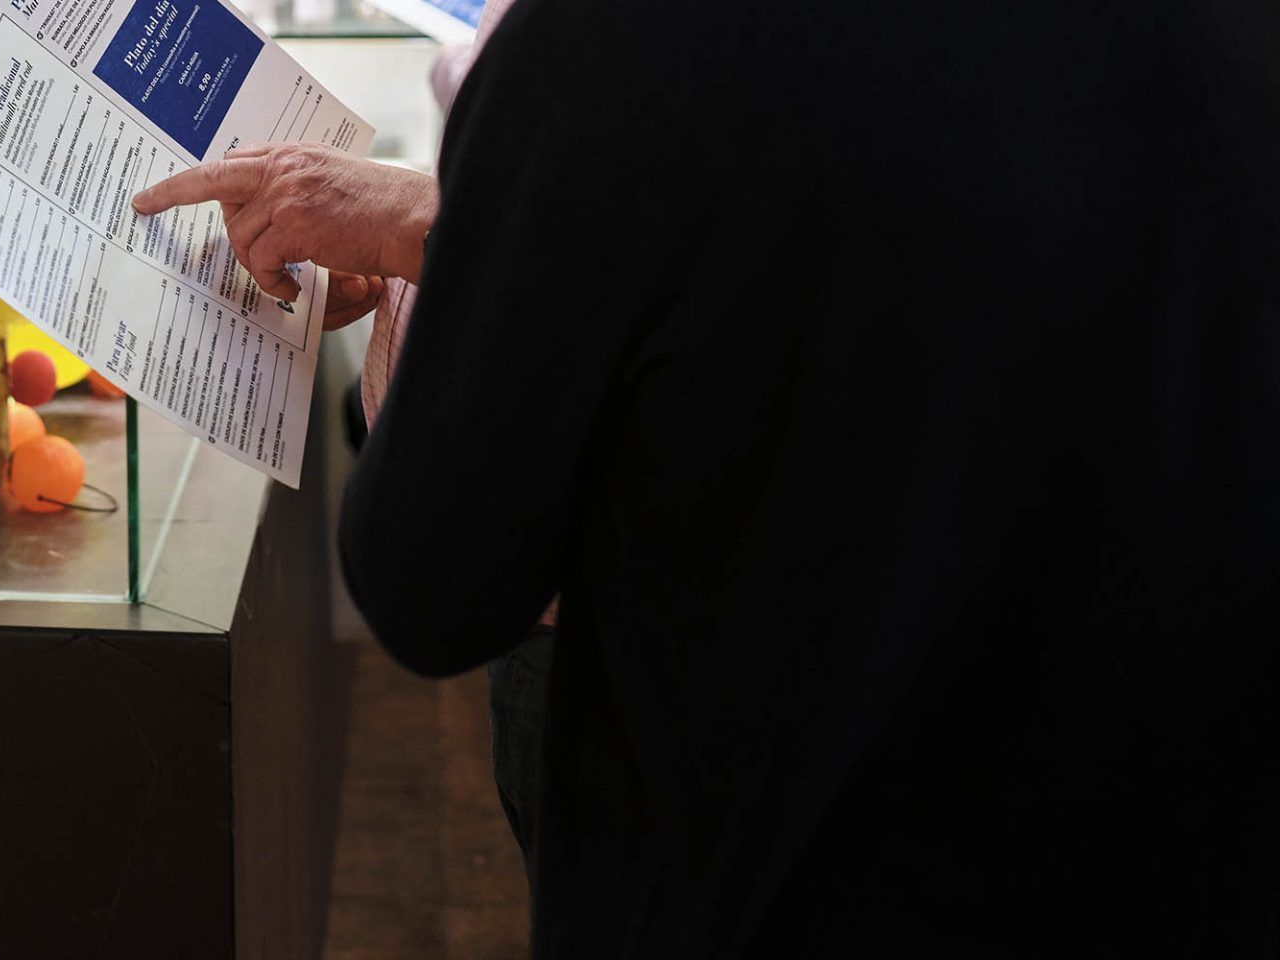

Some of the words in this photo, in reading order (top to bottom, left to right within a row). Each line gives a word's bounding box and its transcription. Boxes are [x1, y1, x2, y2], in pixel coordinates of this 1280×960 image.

[124, 37, 147, 66] Plato
[144, 15, 158, 36] del
[155, 0, 169, 17] día
[134, 39, 159, 74] Today's
[158, 4, 178, 39] special
[14, 74, 26, 100] cured
[23, 59, 32, 78] cod
[178, 70, 188, 84] CAÑA
[188, 51, 198, 66] AGUA
[198, 73, 210, 91] 8,90
[106, 348, 120, 372] Para
[113, 320, 126, 348] picar
[123, 330, 137, 356] food
[118, 352, 133, 381] Finger
